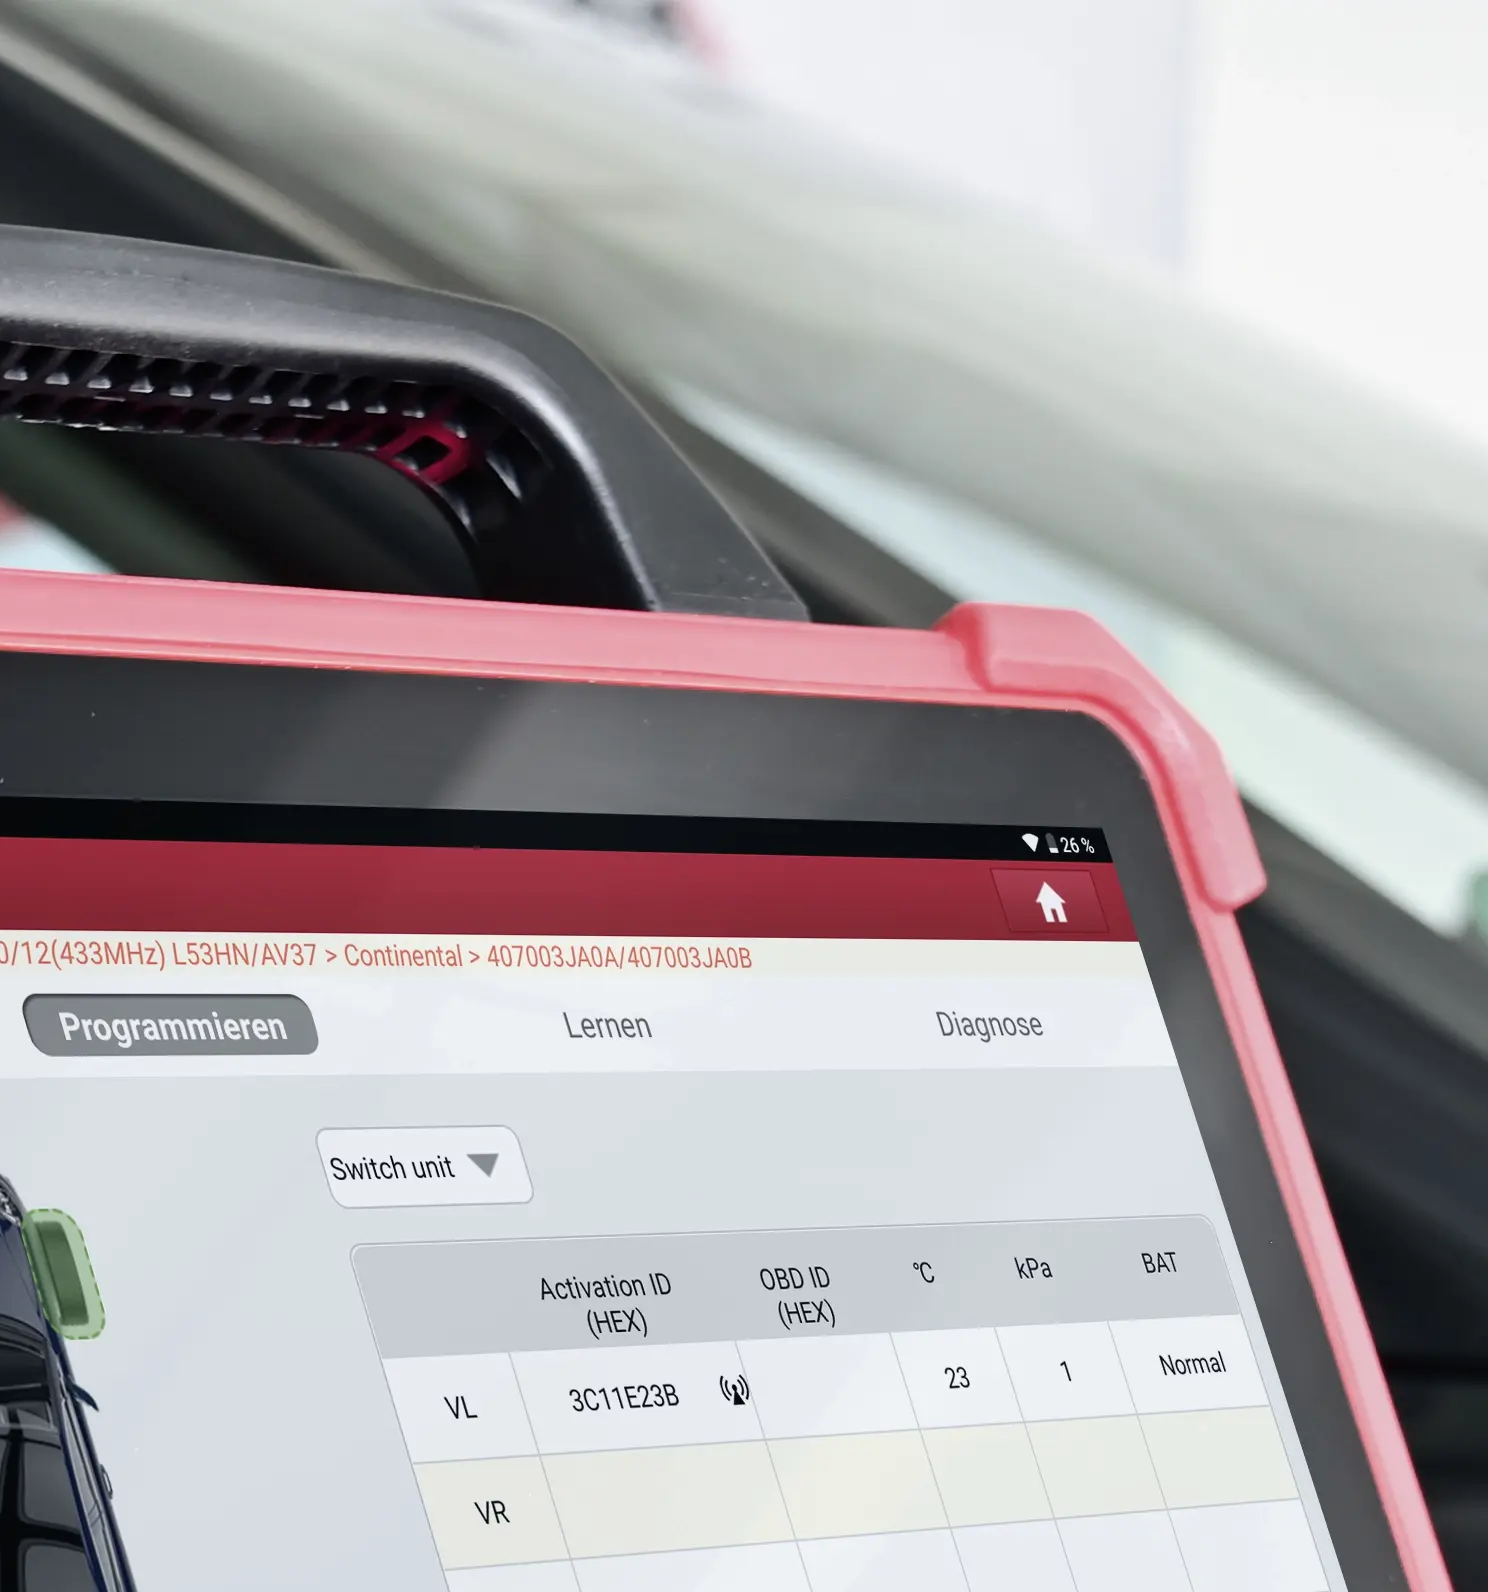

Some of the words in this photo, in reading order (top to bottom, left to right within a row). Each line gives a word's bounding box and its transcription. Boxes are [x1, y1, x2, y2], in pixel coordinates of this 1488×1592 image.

[172, 943, 316, 967] L53HN/AV37
[345, 944, 462, 966] Continental
[488, 945, 752, 969] 407003JA0A/407003JA0B
[59, 1012, 287, 1048] Programmieren
[563, 1012, 652, 1038] Lernen
[936, 1011, 1043, 1043] Diagnose
[330, 1155, 405, 1180] Switch
[412, 1156, 455, 1178] unit
[1014, 1258, 1053, 1279] kPa
[1141, 1252, 1176, 1273] BAT
[542, 1275, 644, 1300] Activation
[649, 1273, 671, 1295] ID
[760, 1268, 804, 1290] OBD
[809, 1267, 830, 1288] ID
[587, 1308, 647, 1340] (HEX)
[778, 1299, 835, 1330] (HEX)
[1060, 1361, 1071, 1381] 1
[1159, 1351, 1226, 1375] Normal
[945, 1367, 970, 1389] 23
[444, 1396, 478, 1419] VL
[570, 1384, 679, 1411] 3C11E23B
[474, 1501, 510, 1524] VR
